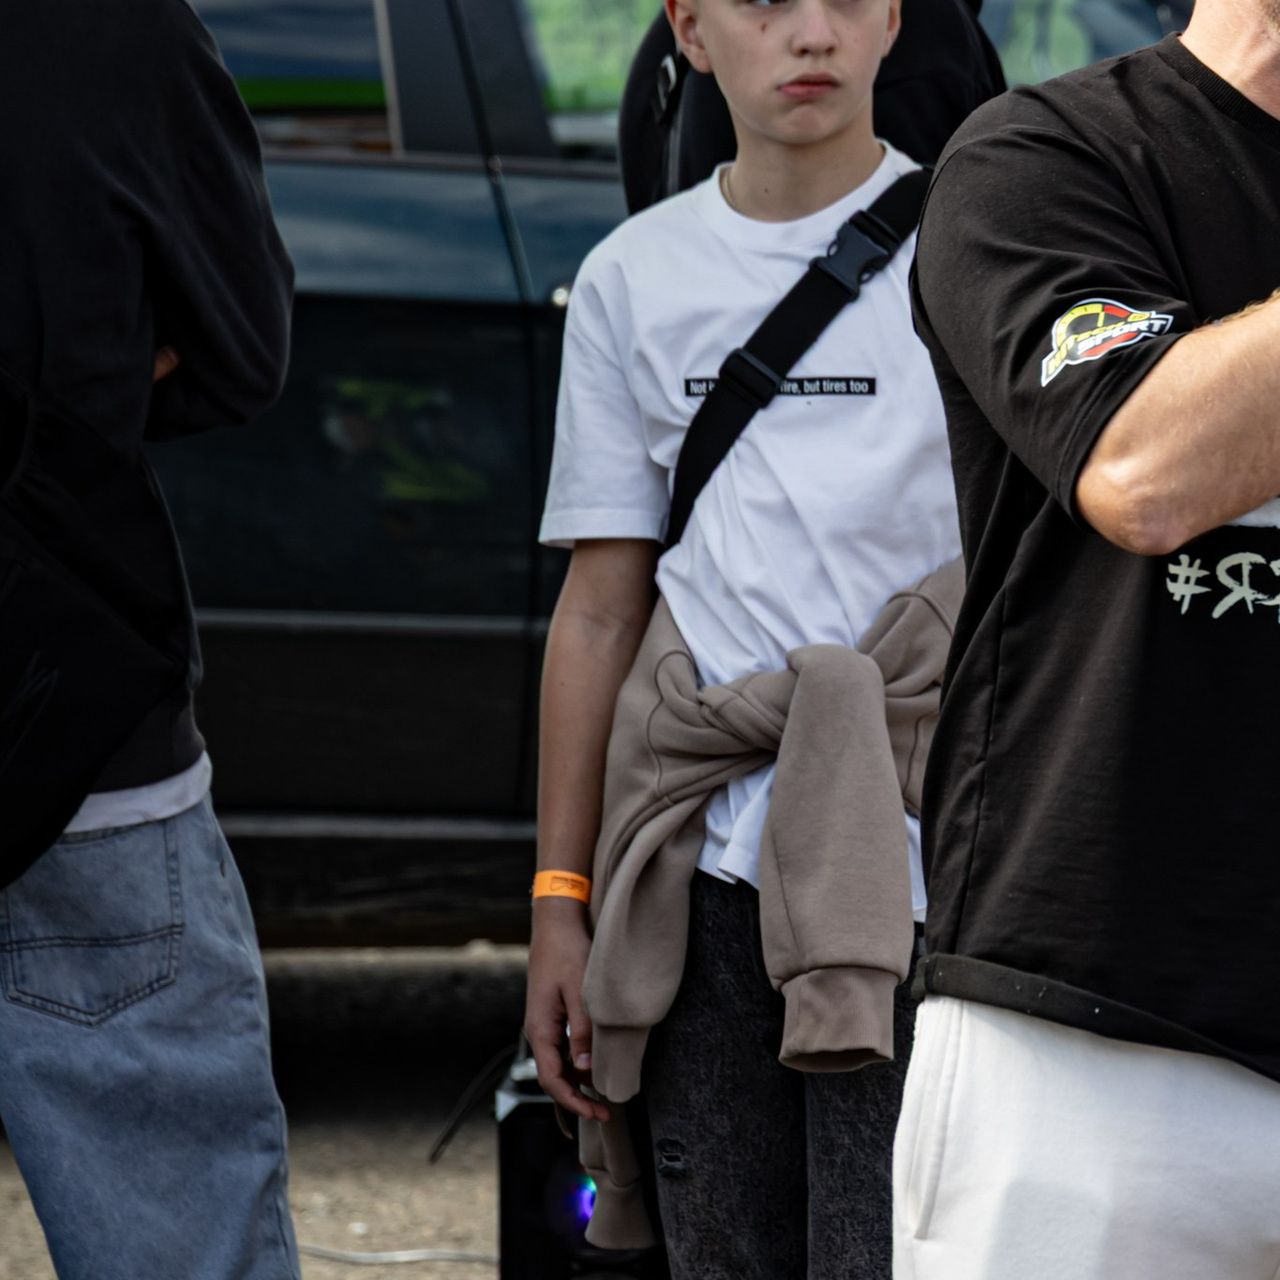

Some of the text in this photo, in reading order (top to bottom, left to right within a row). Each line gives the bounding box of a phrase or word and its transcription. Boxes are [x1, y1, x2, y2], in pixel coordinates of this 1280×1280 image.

[1077, 319, 1167, 355] SPORT
[690, 380, 707, 394] Not
[803, 380, 820, 393] but
[823, 379, 847, 393] tires
[850, 380, 869, 393] too
